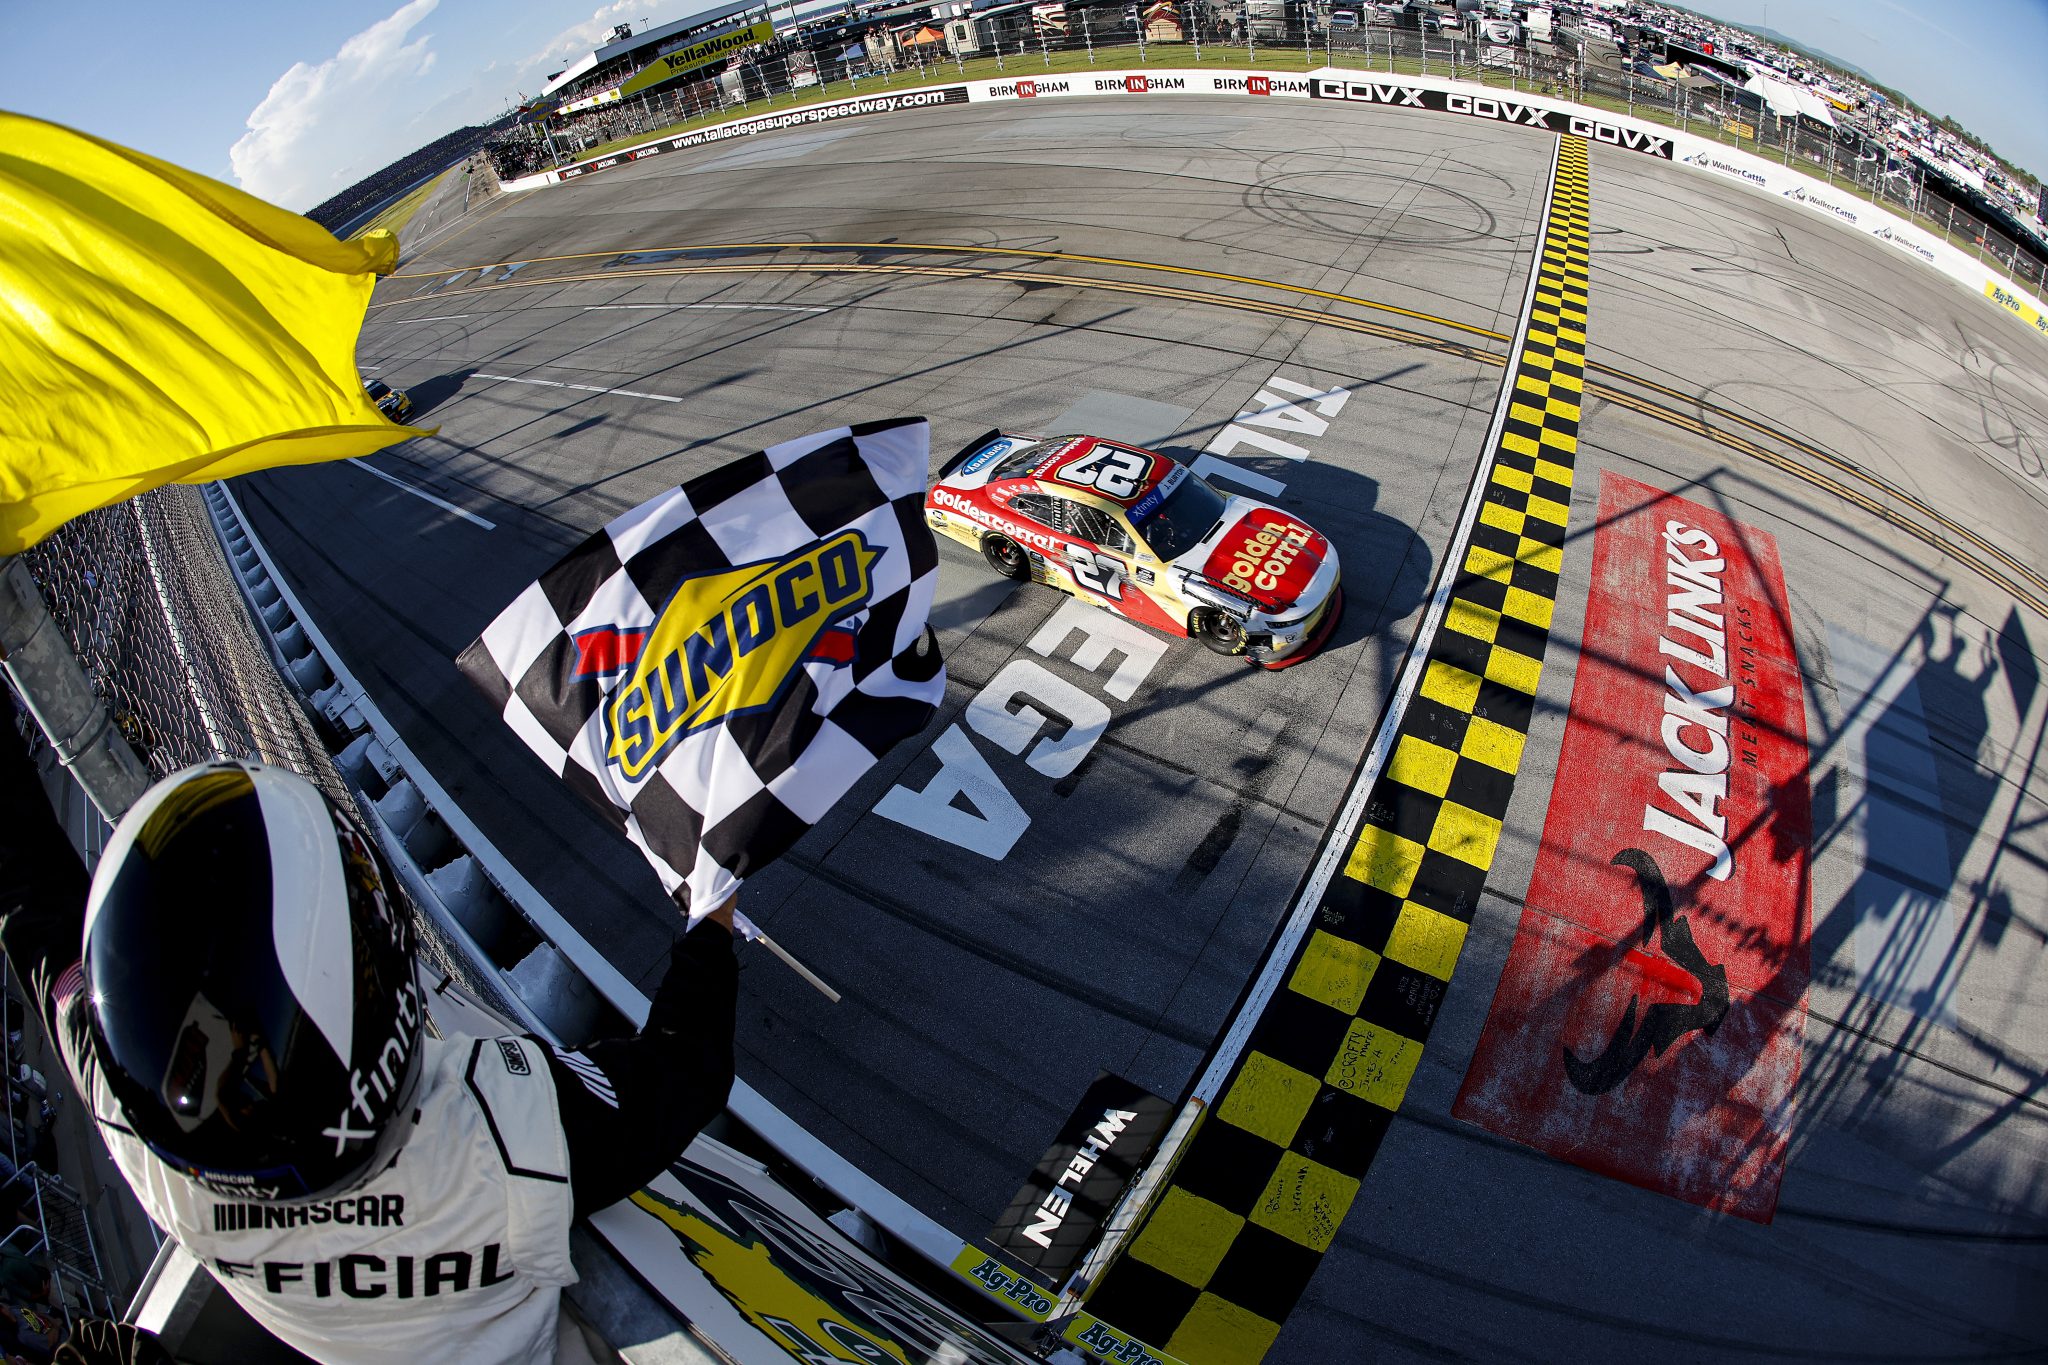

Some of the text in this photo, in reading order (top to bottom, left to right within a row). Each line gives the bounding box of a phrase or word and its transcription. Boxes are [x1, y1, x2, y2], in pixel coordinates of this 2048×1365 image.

[663, 28, 755, 69] YellaWood
[989, 80, 1070, 98] BIRMINGHAM
[1095, 77, 1185, 92] BIRMINGHAM
[1214, 77, 1310, 93] BIRMINGHAM
[1318, 79, 1425, 108] GOVX
[672, 89, 946, 150] www.talladegasuperspeedway.com
[1446, 93, 1550, 129] GOVX
[1569, 116, 1667, 157] GOVX
[1993, 287, 2020, 311] Ag-Pro
[1058, 446, 1146, 497] 27
[1169, 465, 1185, 486] BURTON
[933, 488, 991, 527] golden
[1132, 494, 1159, 517] xfinity
[1066, 543, 1129, 600] 27
[1222, 522, 1287, 593] golden
[1254, 522, 1313, 591] corral
[616, 540, 862, 767] SUNOCO
[1736, 603, 1758, 769] MEAT SNACKS
[1642, 664, 1736, 881] JACK
[321, 955, 422, 1158] xfinity
[1022, 1108, 1138, 1250] WHELEN
[264, 1194, 405, 1230] NASCAR
[214, 1243, 515, 1299] FFICIAL
[969, 1257, 1052, 1315] Ag-Pro
